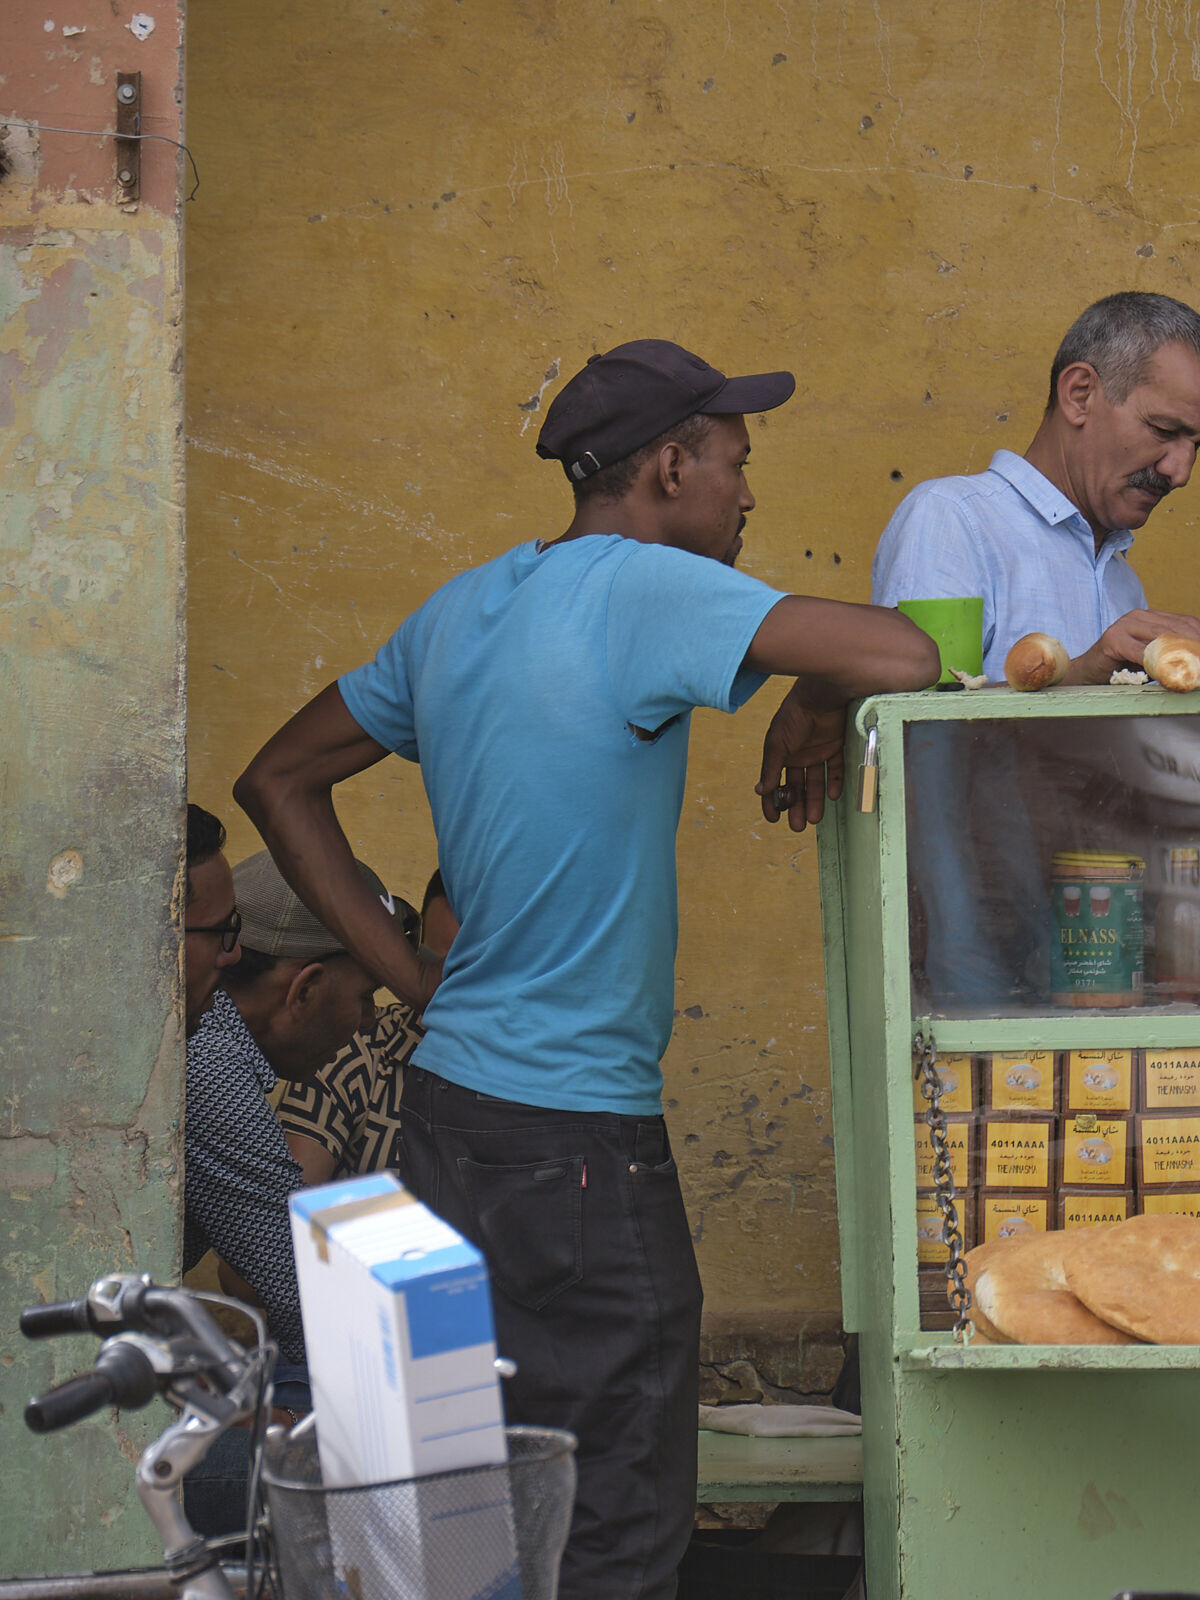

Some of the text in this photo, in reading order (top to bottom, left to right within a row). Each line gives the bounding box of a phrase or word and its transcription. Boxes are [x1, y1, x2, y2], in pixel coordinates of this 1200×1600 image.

[1107, 1052, 1124, 1063] شاي
[1102, 1125, 1119, 1137] شاي
[991, 1140, 1044, 1149] 4011AAAA
[1146, 1136, 1199, 1144] 4011AAAA
[1022, 1205, 1039, 1216] شاي
[1068, 1214, 1121, 1222] 4011AAAA
